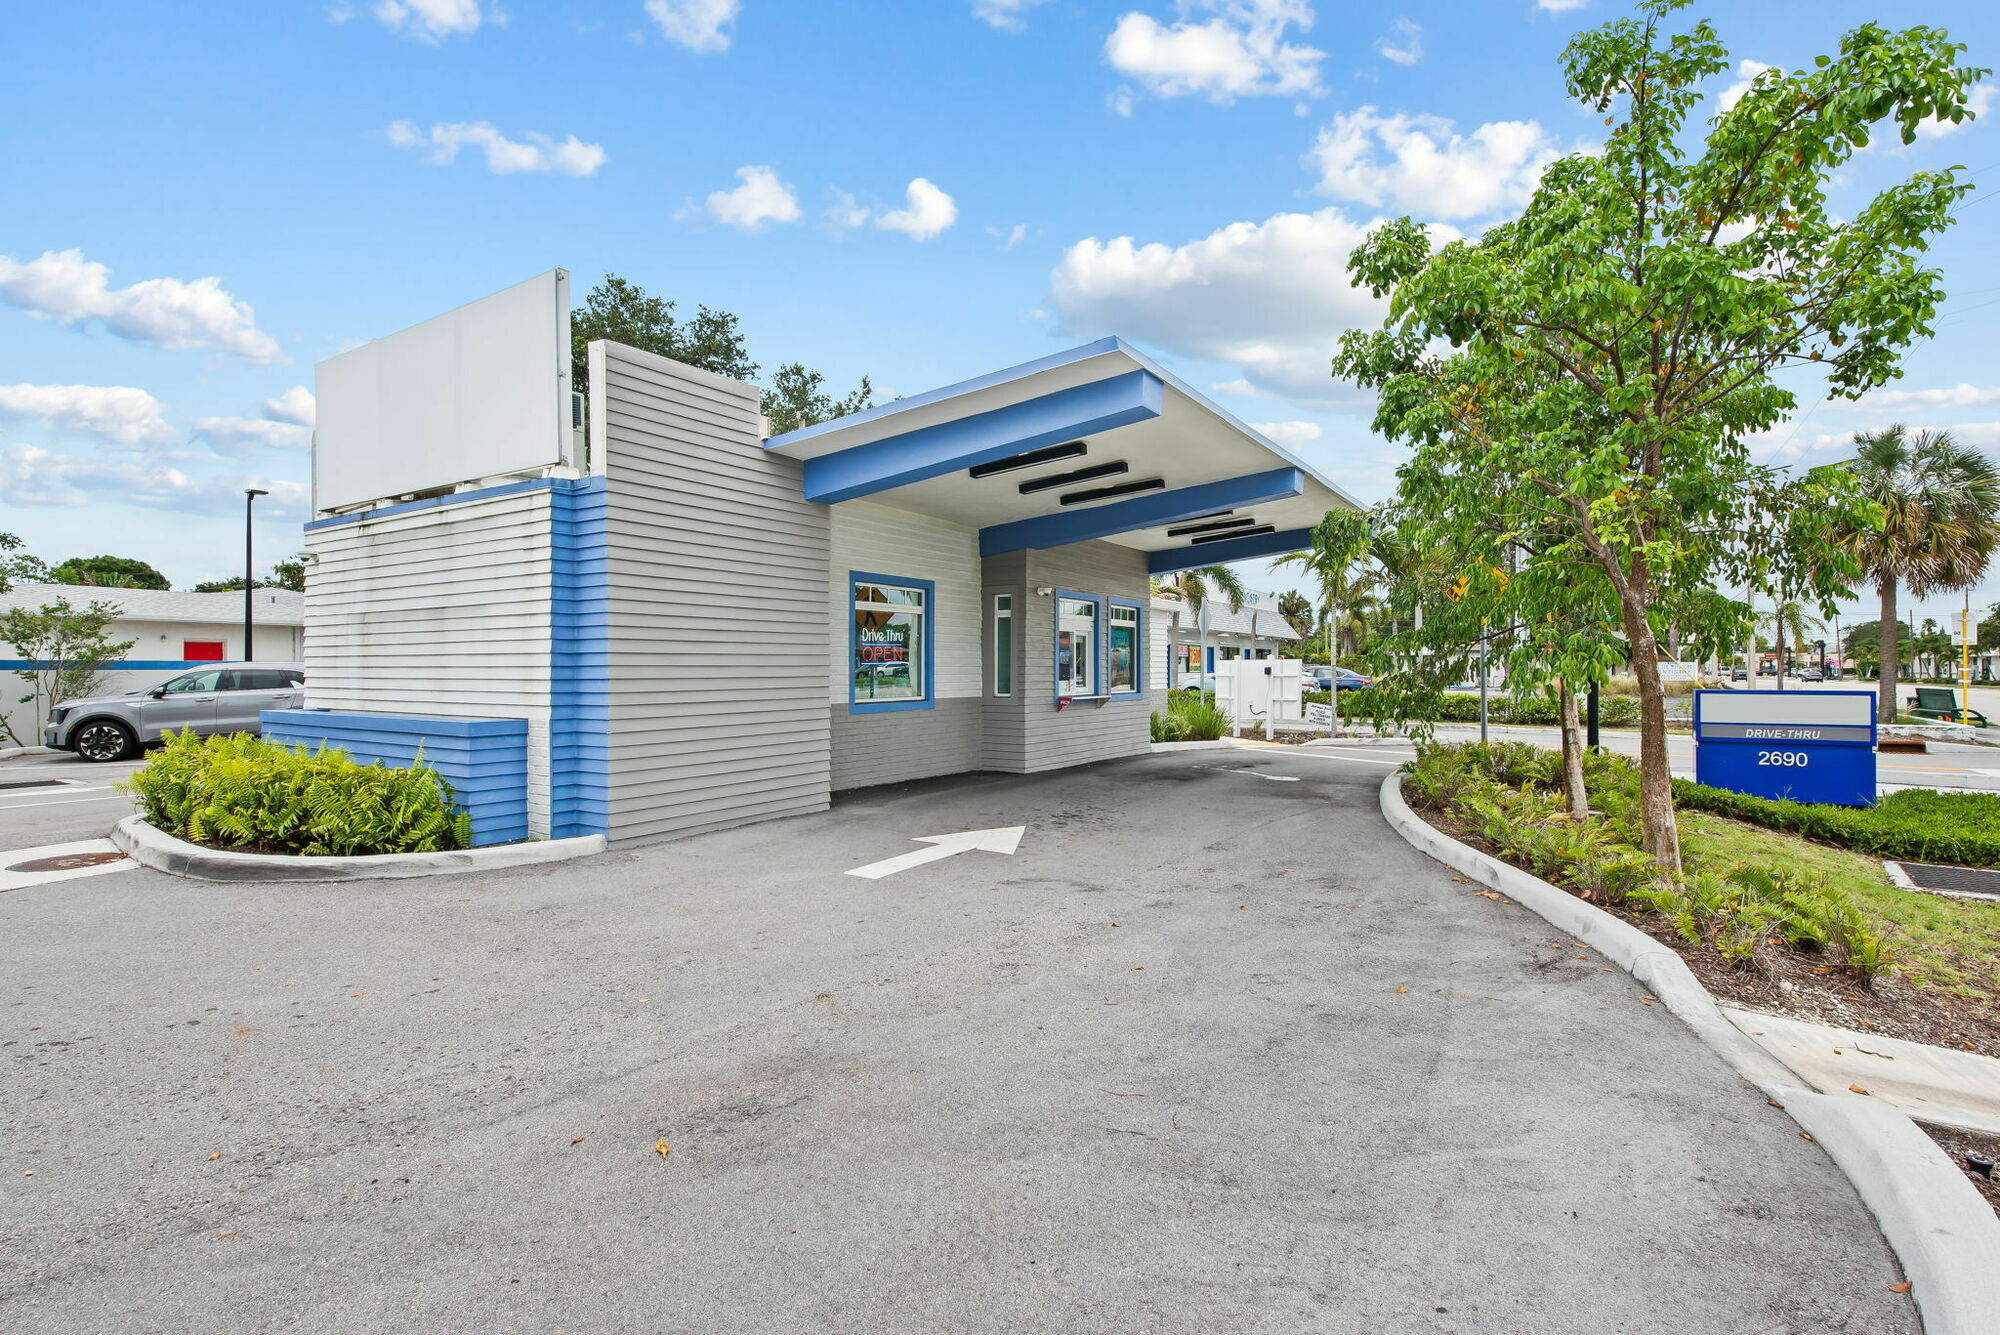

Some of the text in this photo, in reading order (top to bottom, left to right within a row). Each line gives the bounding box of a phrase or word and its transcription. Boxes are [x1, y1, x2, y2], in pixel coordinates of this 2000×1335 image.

[862, 627, 904, 642] Drive-Thru
[862, 646, 904, 662] OPEN
[1745, 728, 1821, 740] DRIVE-THRU
[1758, 750, 1809, 767] 2690
